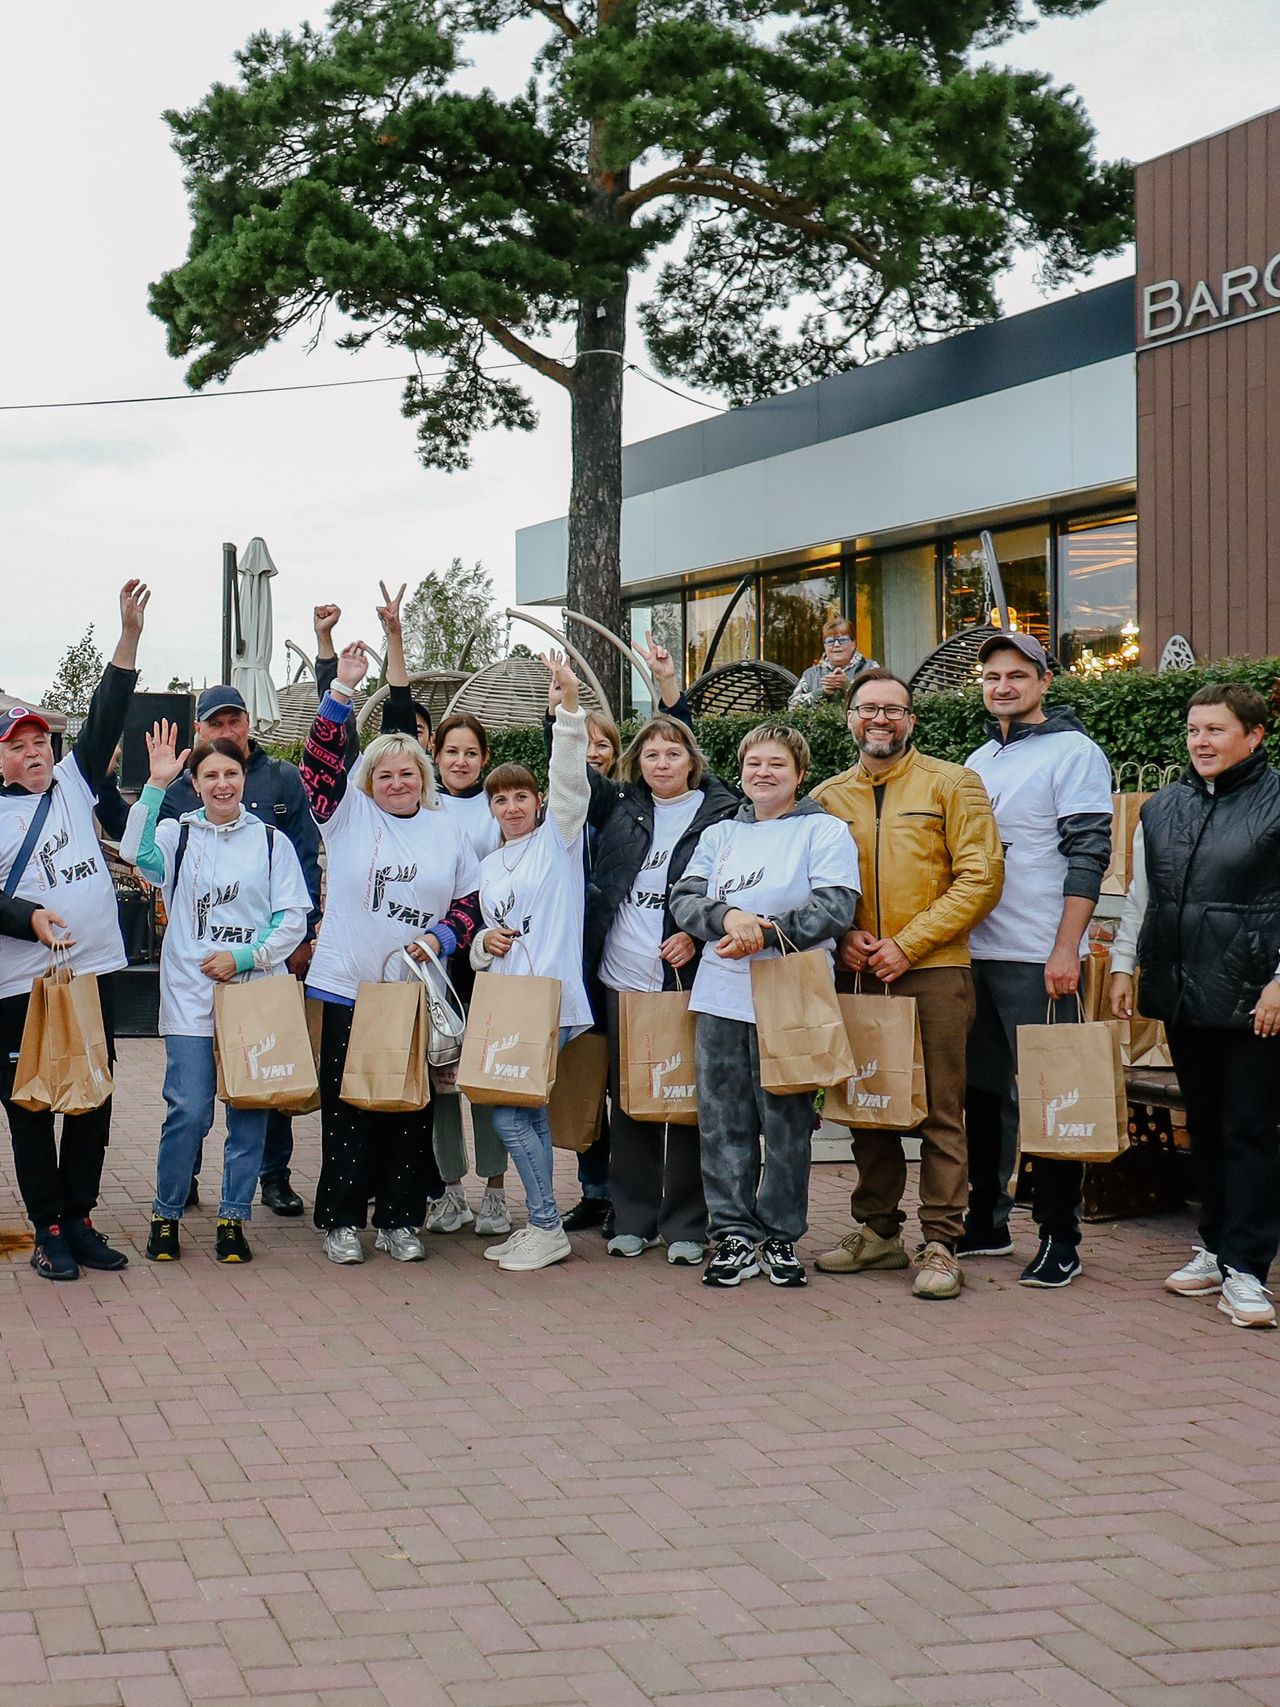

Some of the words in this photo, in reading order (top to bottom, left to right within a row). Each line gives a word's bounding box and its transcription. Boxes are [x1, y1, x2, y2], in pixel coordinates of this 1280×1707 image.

[60, 857, 99, 885] УМТ
[636, 890, 666, 911] УМ
[387, 900, 435, 929] УМТ
[210, 925, 256, 944] УМТ
[260, 1063, 296, 1080] УМТ
[493, 1063, 531, 1079] УМТ
[662, 1084, 697, 1099] УМТ
[856, 1093, 892, 1109] УМТ
[1057, 1123, 1097, 1137] УМТ
